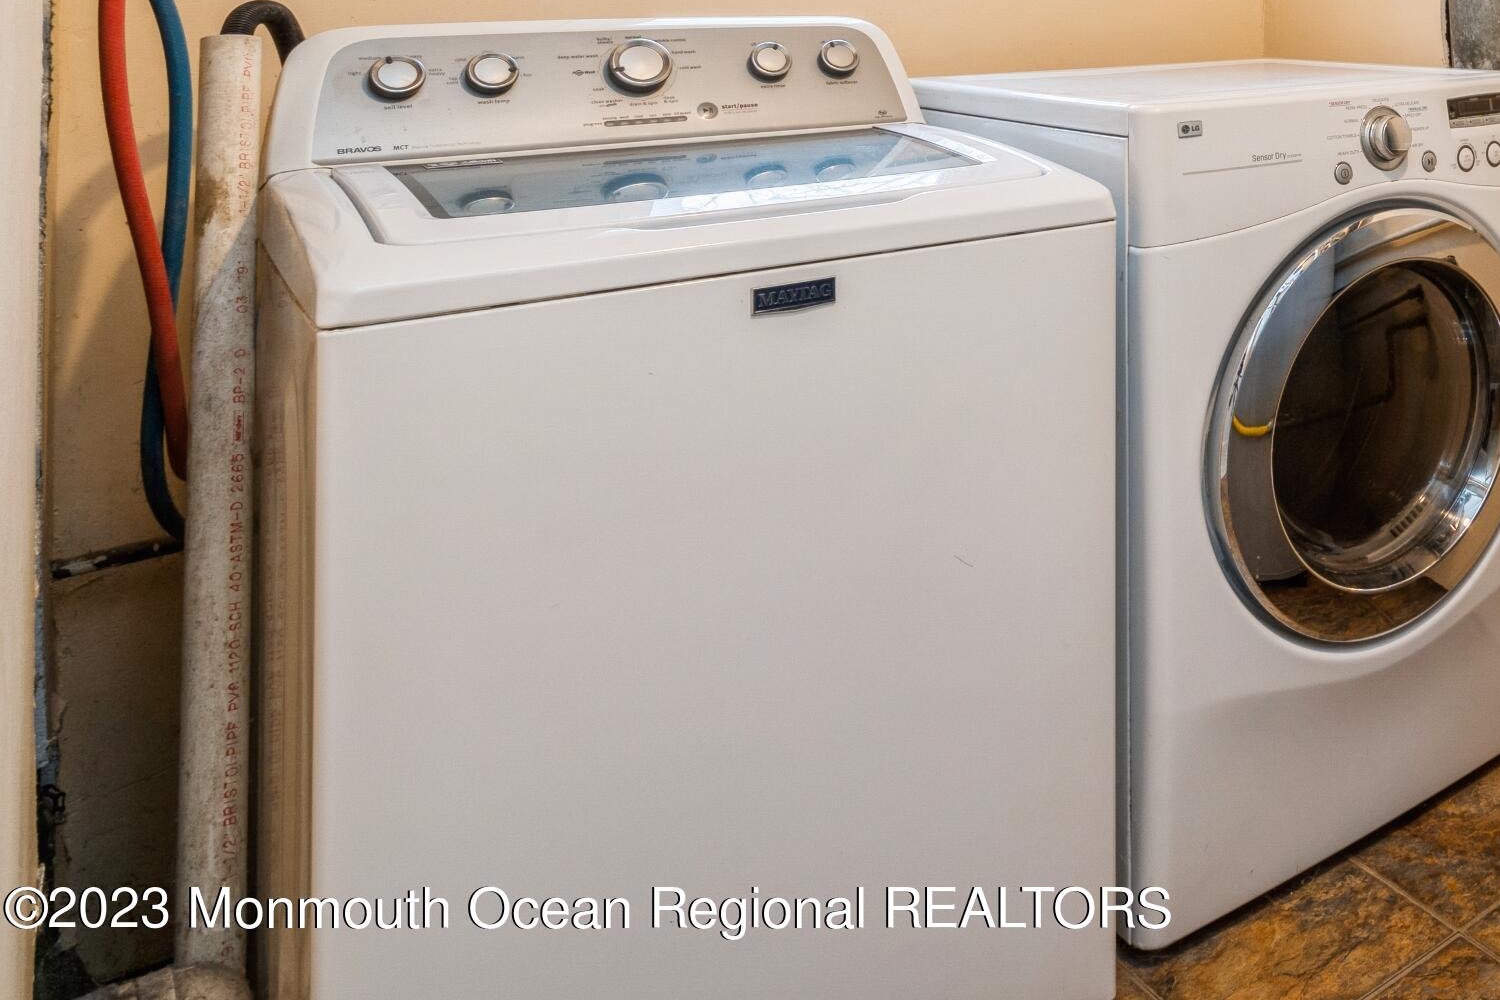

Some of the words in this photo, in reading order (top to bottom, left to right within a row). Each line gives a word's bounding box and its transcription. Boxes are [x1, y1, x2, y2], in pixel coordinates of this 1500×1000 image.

[721, 102, 758, 110] start/pause
[336, 145, 382, 154] BRAVOS
[1251, 152, 1275, 162] Sensor
[1276, 151, 1287, 162] Dry
[758, 283, 832, 308] MAYTAG
[230, 453, 245, 493] 2665
[229, 501, 243, 562] ASTM-D
[229, 572, 242, 591] 40
[229, 601, 242, 631] SCH
